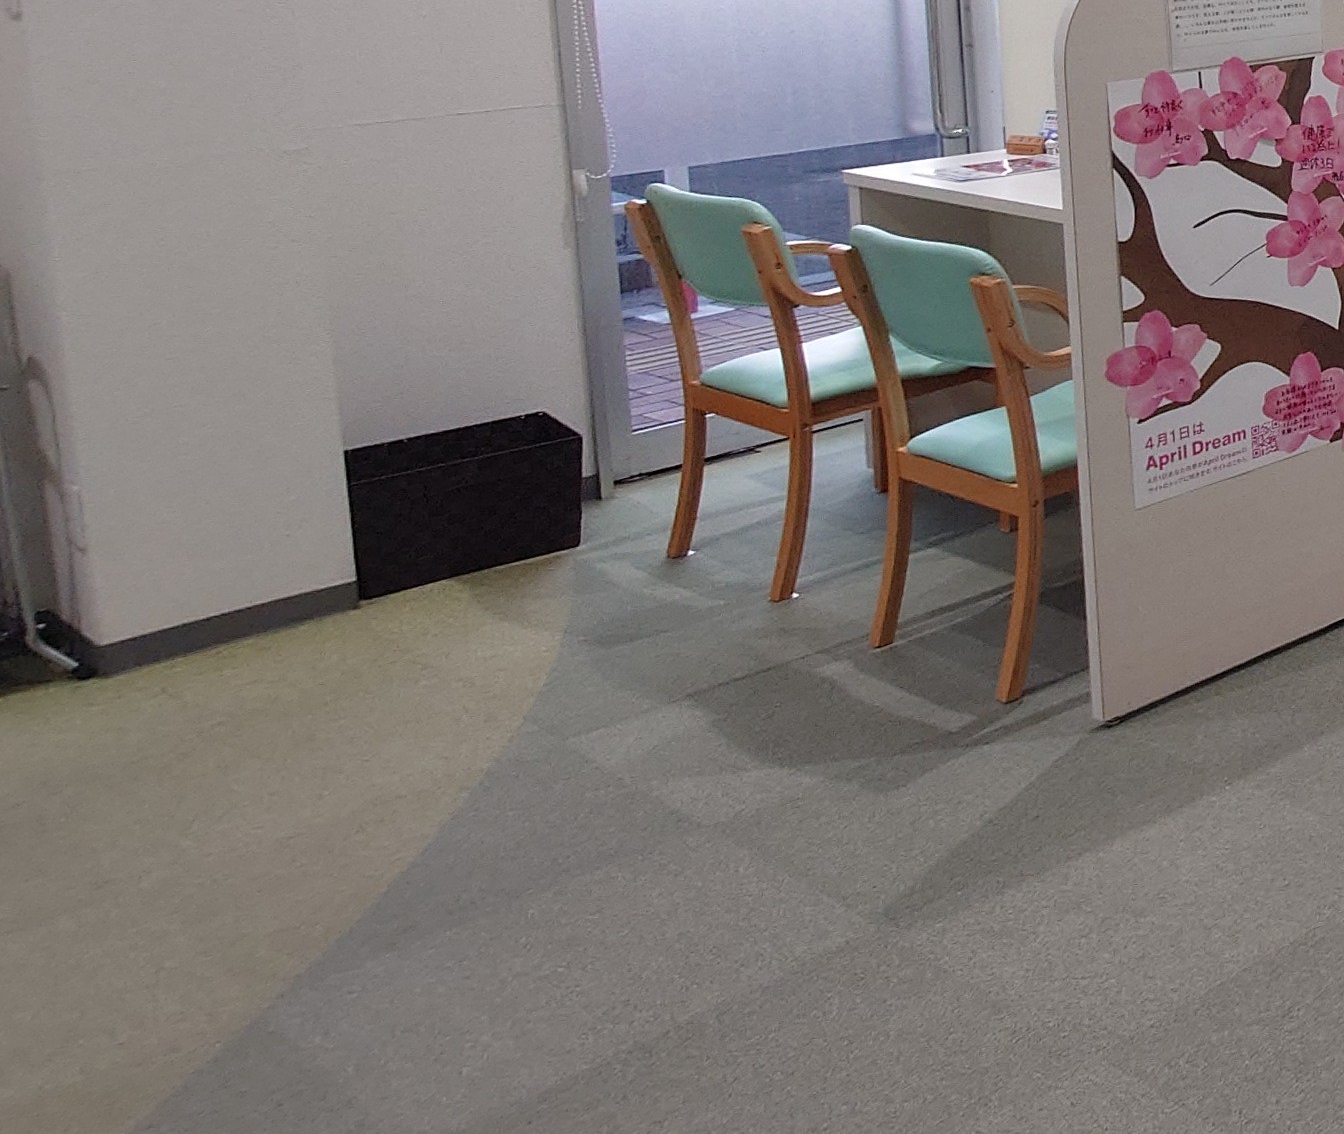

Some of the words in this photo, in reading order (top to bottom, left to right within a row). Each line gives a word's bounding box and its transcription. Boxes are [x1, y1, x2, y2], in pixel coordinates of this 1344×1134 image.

[1145, 422, 1206, 450] 4月1日は
[1146, 444, 1187, 471] April
[1192, 429, 1247, 456] Dream
